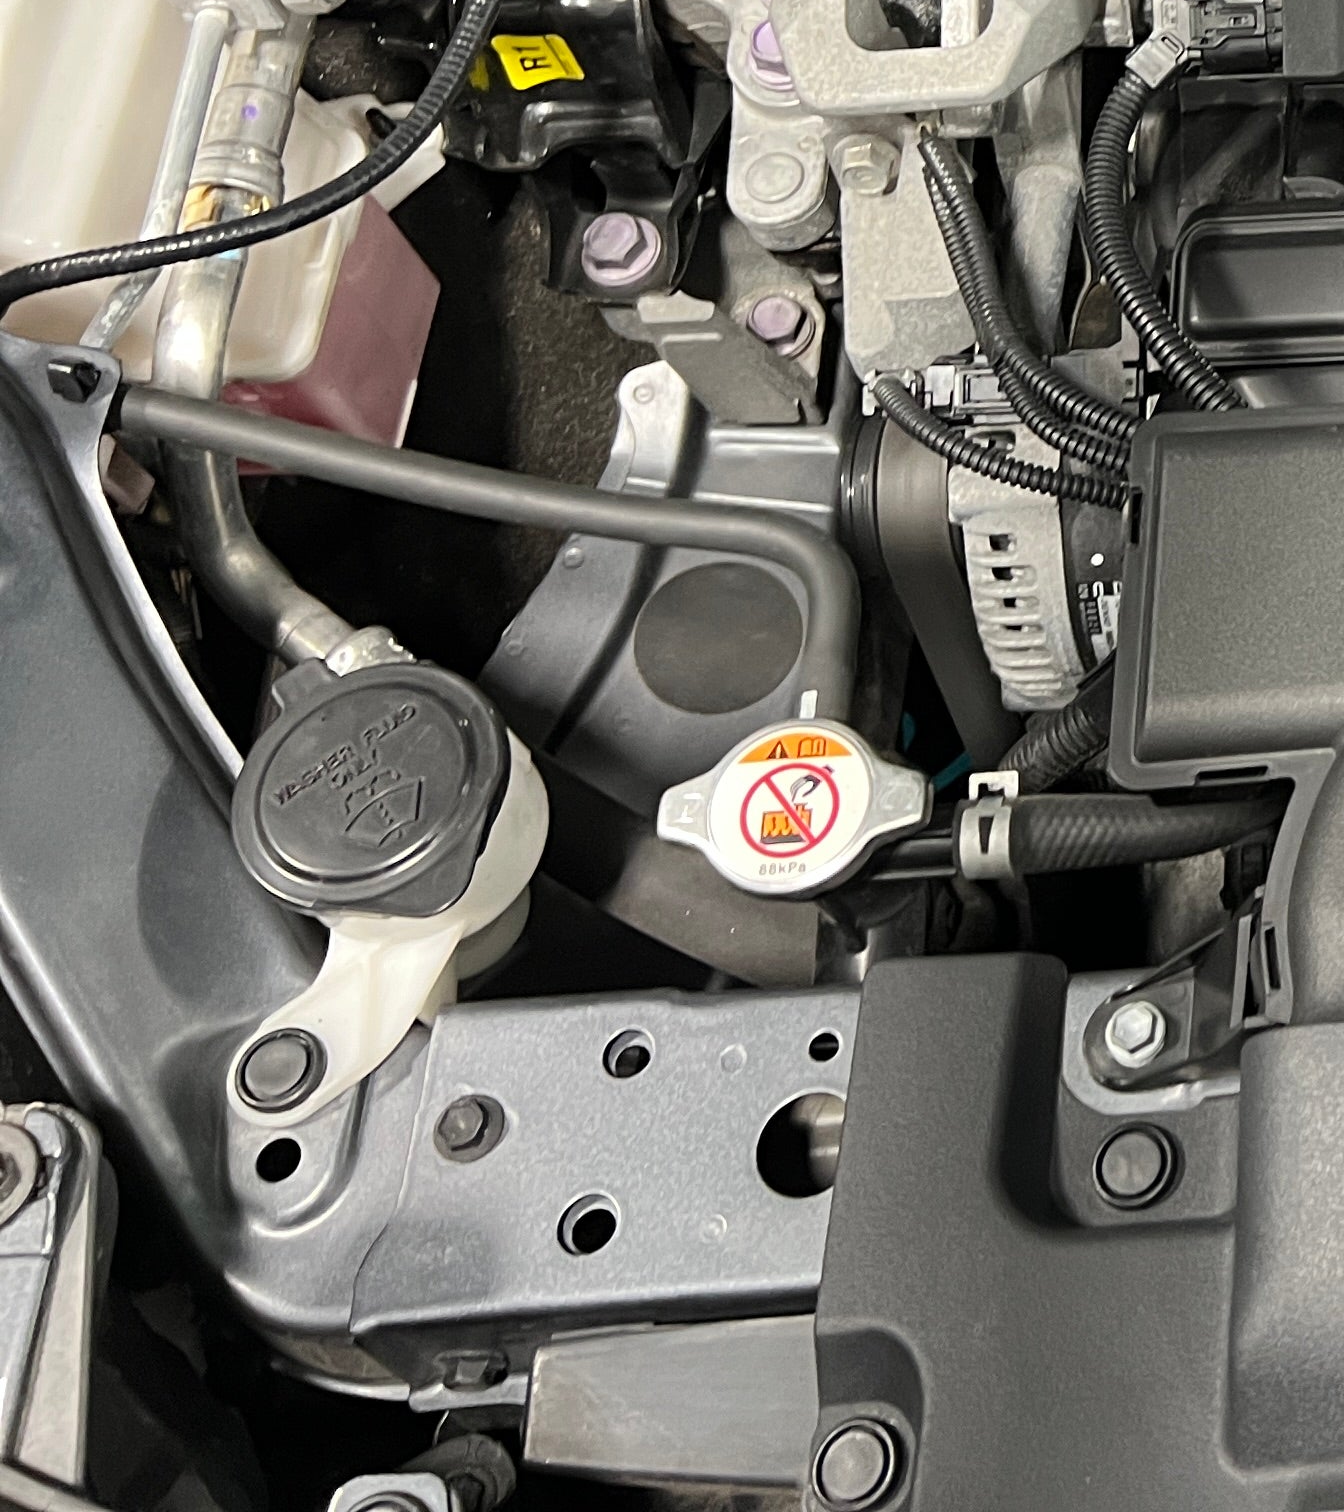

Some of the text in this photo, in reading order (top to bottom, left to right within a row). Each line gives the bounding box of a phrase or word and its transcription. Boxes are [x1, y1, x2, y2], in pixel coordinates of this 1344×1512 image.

[512, 45, 552, 72] R1
[272, 703, 417, 806] WASHER FLUID
[758, 860, 807, 877] 88kPa
